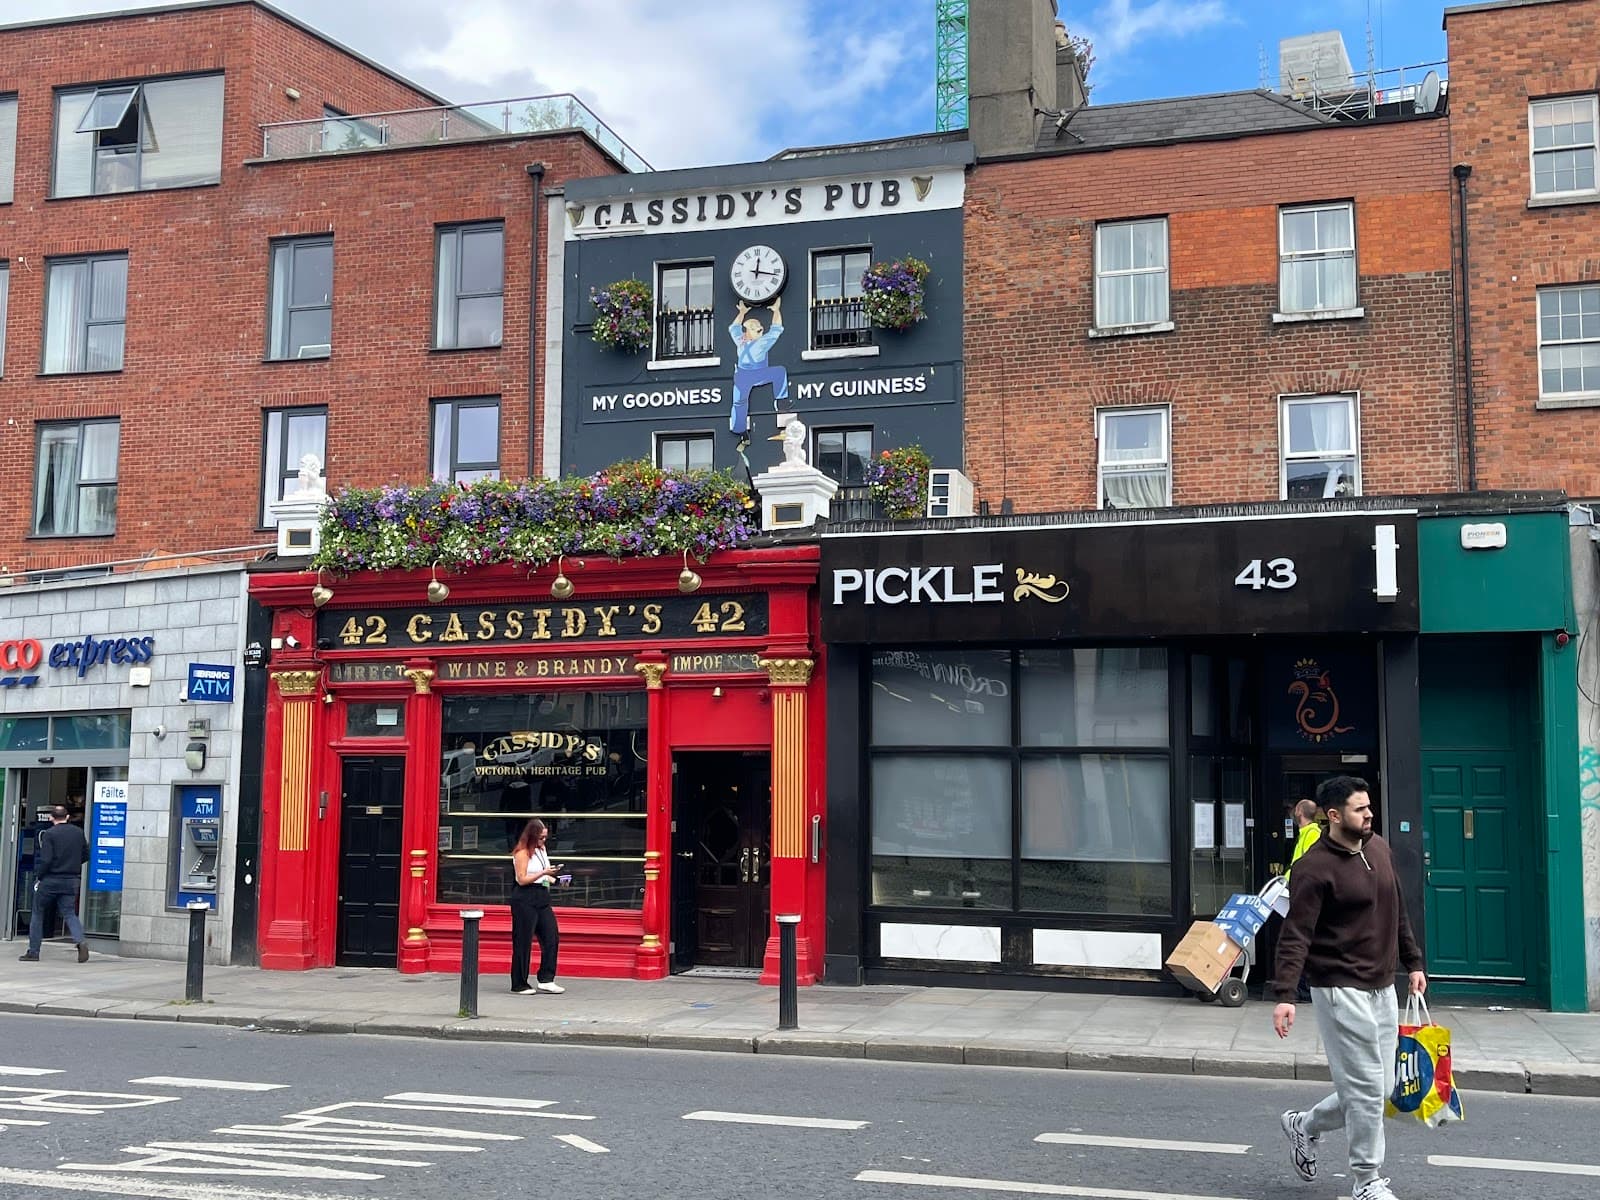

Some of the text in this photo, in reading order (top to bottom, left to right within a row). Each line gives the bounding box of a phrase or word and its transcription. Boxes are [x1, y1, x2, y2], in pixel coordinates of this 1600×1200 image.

[594, 180, 901, 229] CASSIDY'S PUB
[592, 388, 722, 411] MY GOODNESS
[798, 376, 926, 400] MY GUINNESS
[832, 563, 1004, 605] PICKLE
[1234, 557, 1298, 590] 43
[339, 601, 746, 645] 42 CASSIDY'S 42
[50, 635, 155, 677] express
[448, 658, 629, 679] WINE & BRANDY
[192, 679, 230, 695] ATM
[483, 732, 601, 761] CASSIDY'S
[475, 766, 607, 775] VICTORIAN HERITAGE PUB
[195, 804, 213, 814] ATM
